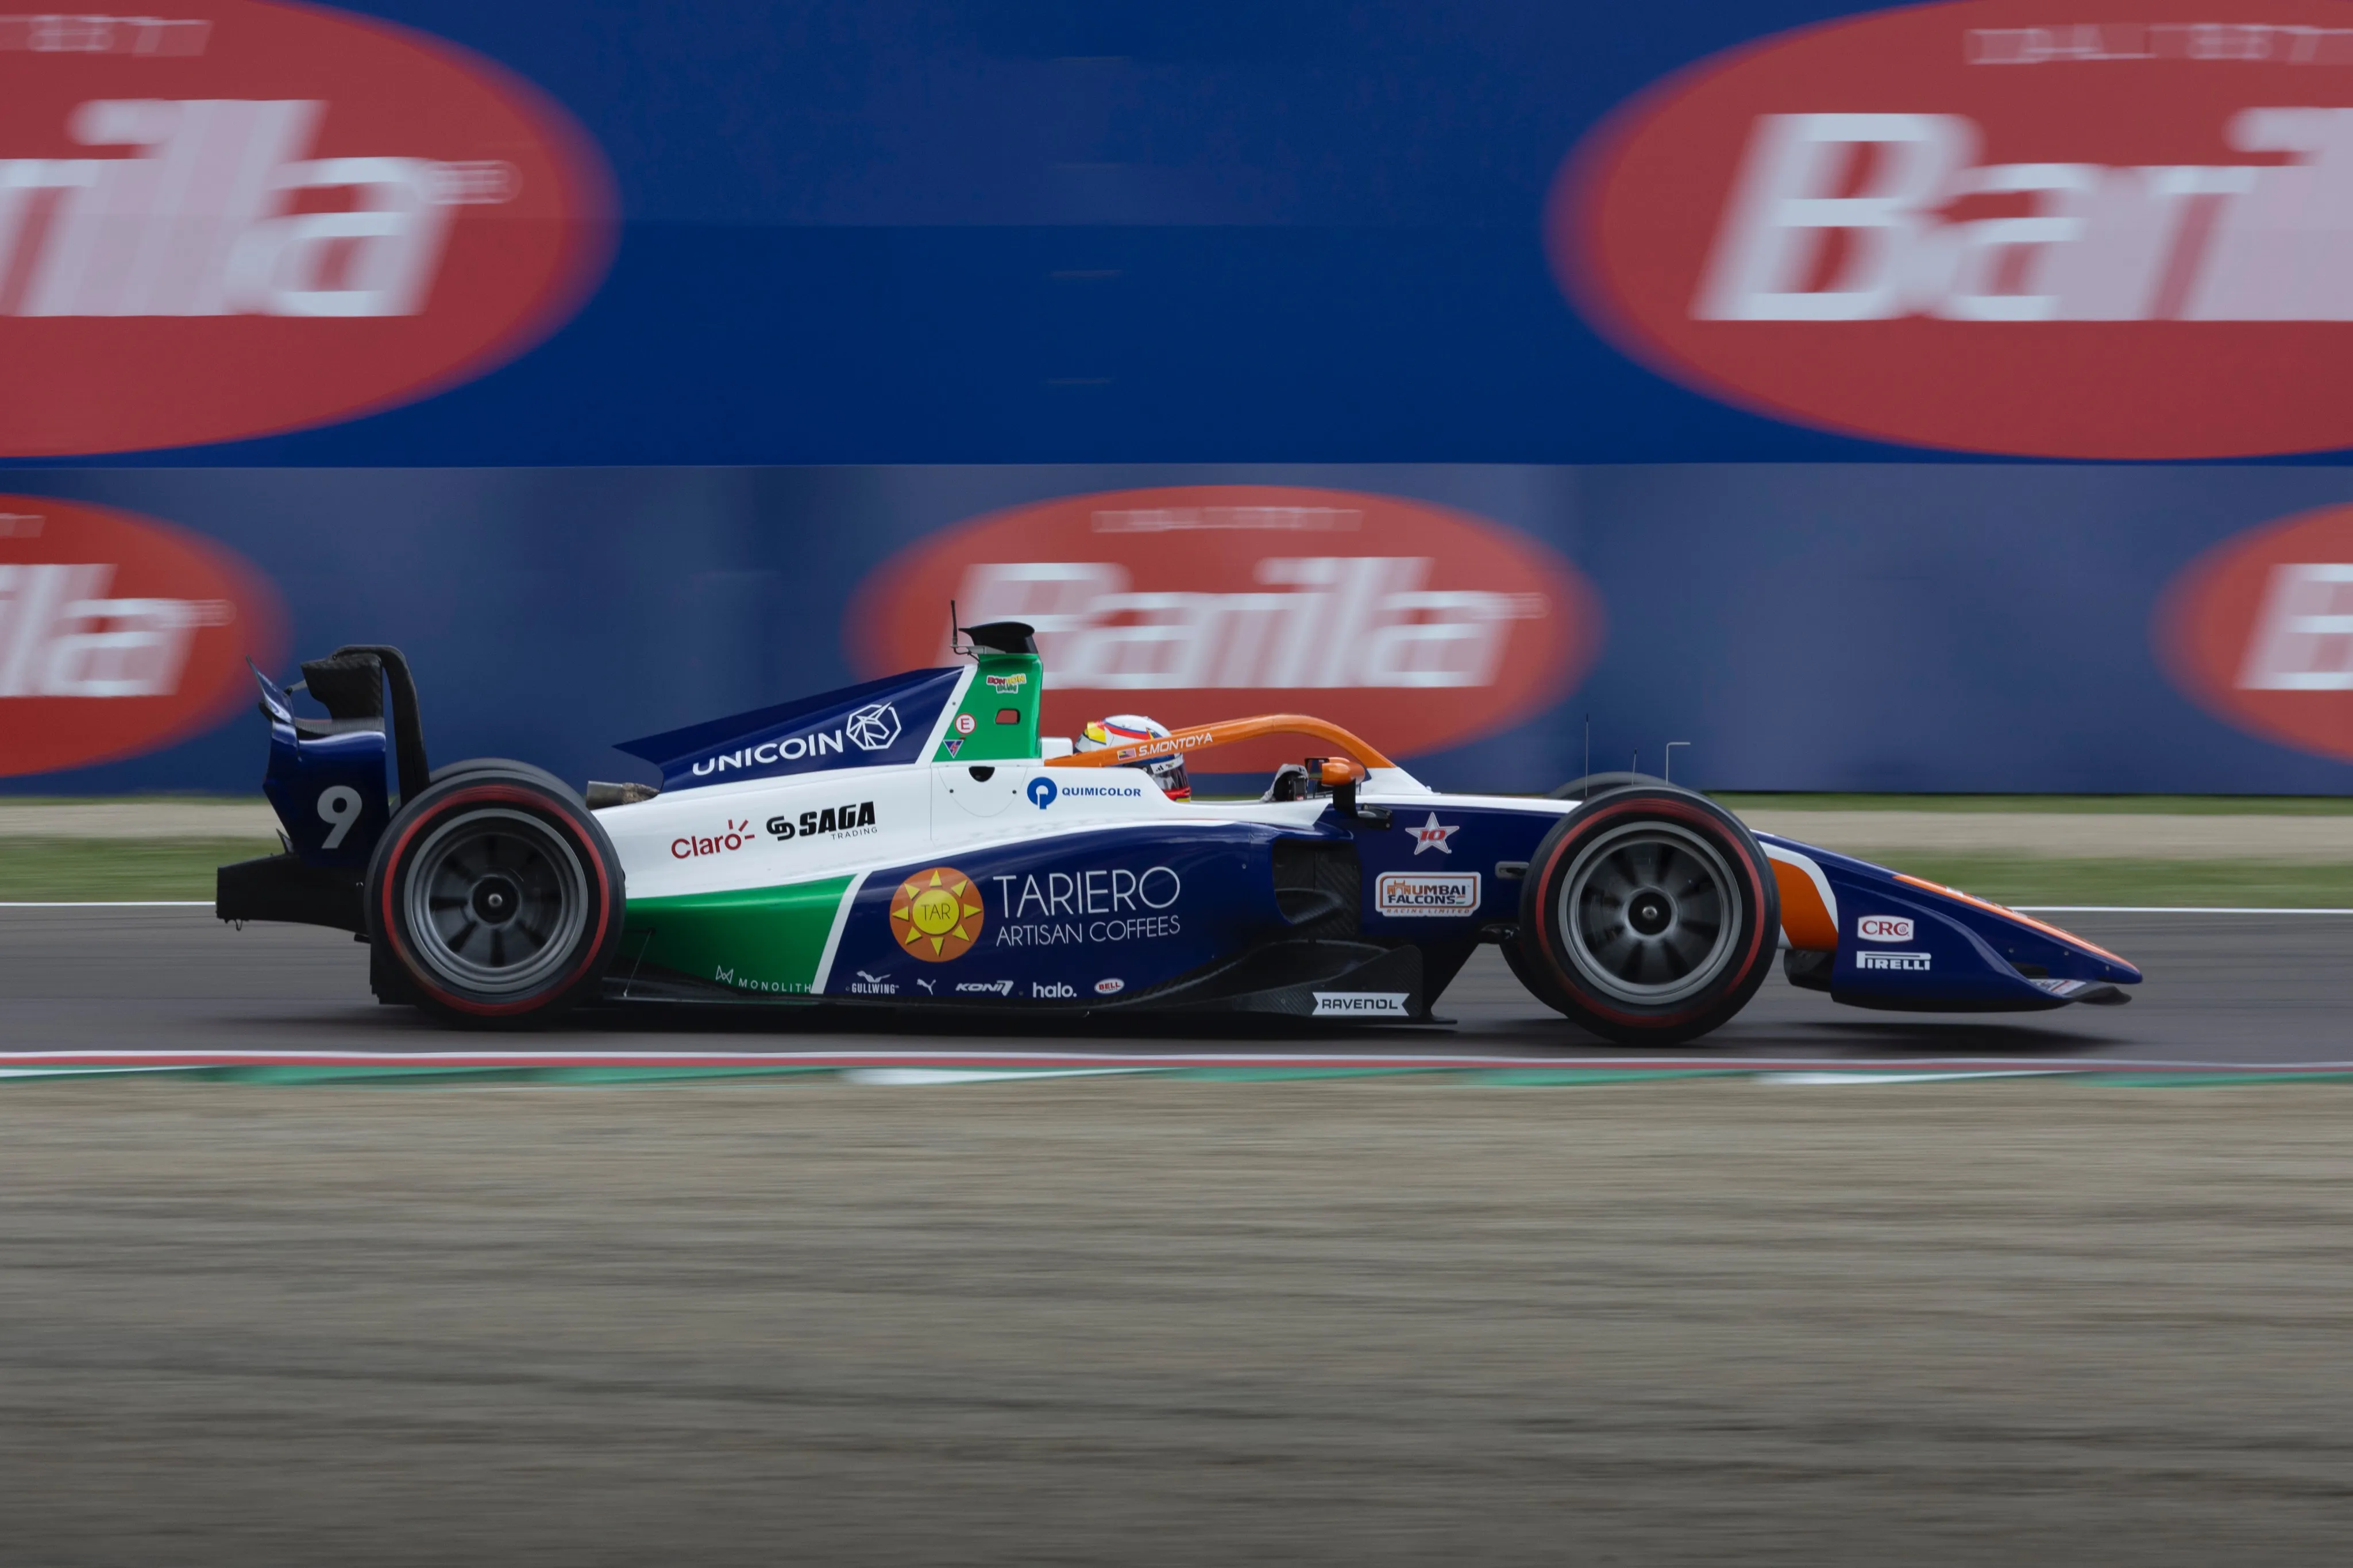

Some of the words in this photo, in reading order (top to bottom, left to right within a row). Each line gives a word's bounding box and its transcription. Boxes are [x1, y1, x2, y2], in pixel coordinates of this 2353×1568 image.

[961, 718, 970, 730] E
[692, 729, 843, 776] UNICOIN
[1139, 732, 1213, 757] S.MONTOYA
[1062, 787, 1141, 797] QUIMICOLOR
[317, 785, 362, 849] 9
[799, 801, 875, 836] SAGA
[831, 827, 878, 840] TRADING
[1419, 830, 1446, 841] 10
[671, 832, 742, 859] Claro
[993, 866, 1181, 918] TARIERO
[1388, 895, 1455, 904] FALCONS
[921, 903, 951, 921] TAR
[996, 923, 1082, 947] ARTISAN
[1090, 914, 1181, 942] COFFEES
[1862, 920, 1910, 936] CRC
[1856, 951, 1931, 971] PIRELLI
[739, 978, 811, 992] MONOLITH
[852, 983, 896, 994] GULLWING
[1099, 982, 1121, 990] BELL
[1322, 999, 1398, 1010] RAVENOL
